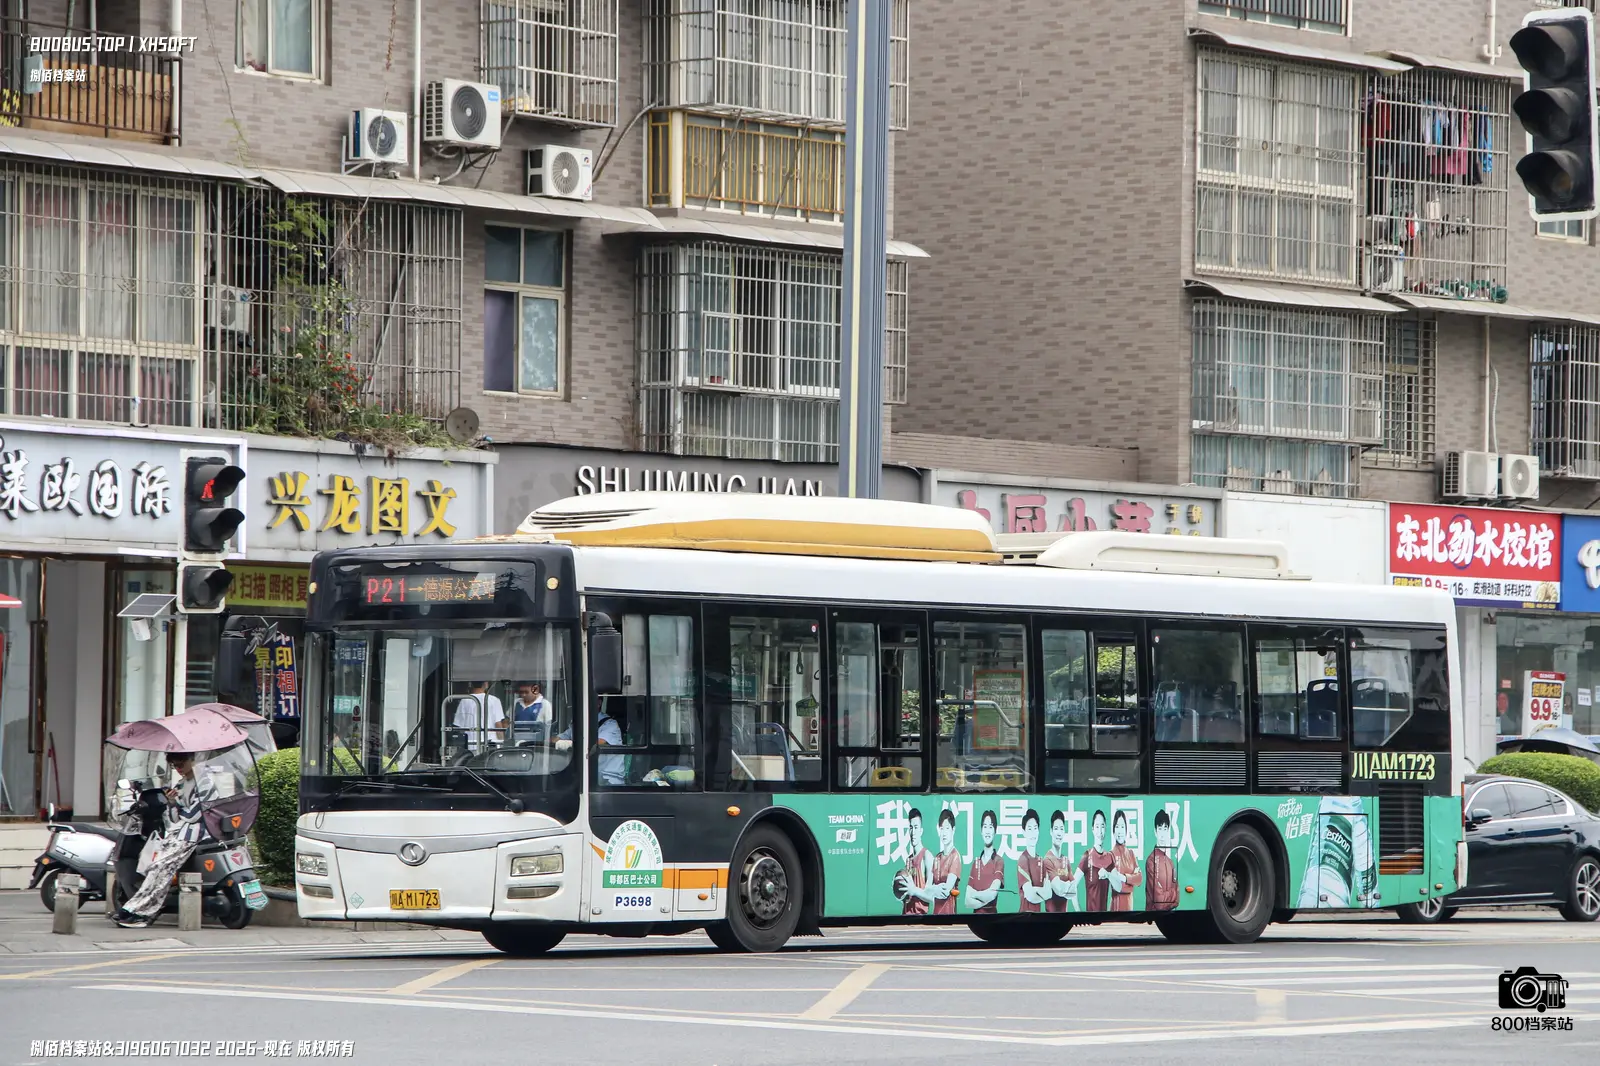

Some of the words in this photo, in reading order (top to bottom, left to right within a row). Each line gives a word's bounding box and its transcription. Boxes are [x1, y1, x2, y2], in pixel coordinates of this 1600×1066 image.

[0, 449, 172, 520] 莱欧国际
[266, 471, 457, 538] 兴龙图文
[1396, 514, 1554, 570] 东北劲水饺馆
[366, 577, 405, 603] P21
[1530, 698, 1551, 721] 9.9
[1351, 752, 1435, 780] 川AM1723
[828, 815, 845, 824] TEAM
[845, 814, 865, 823] CHINA
[615, 896, 652, 907] P3698
